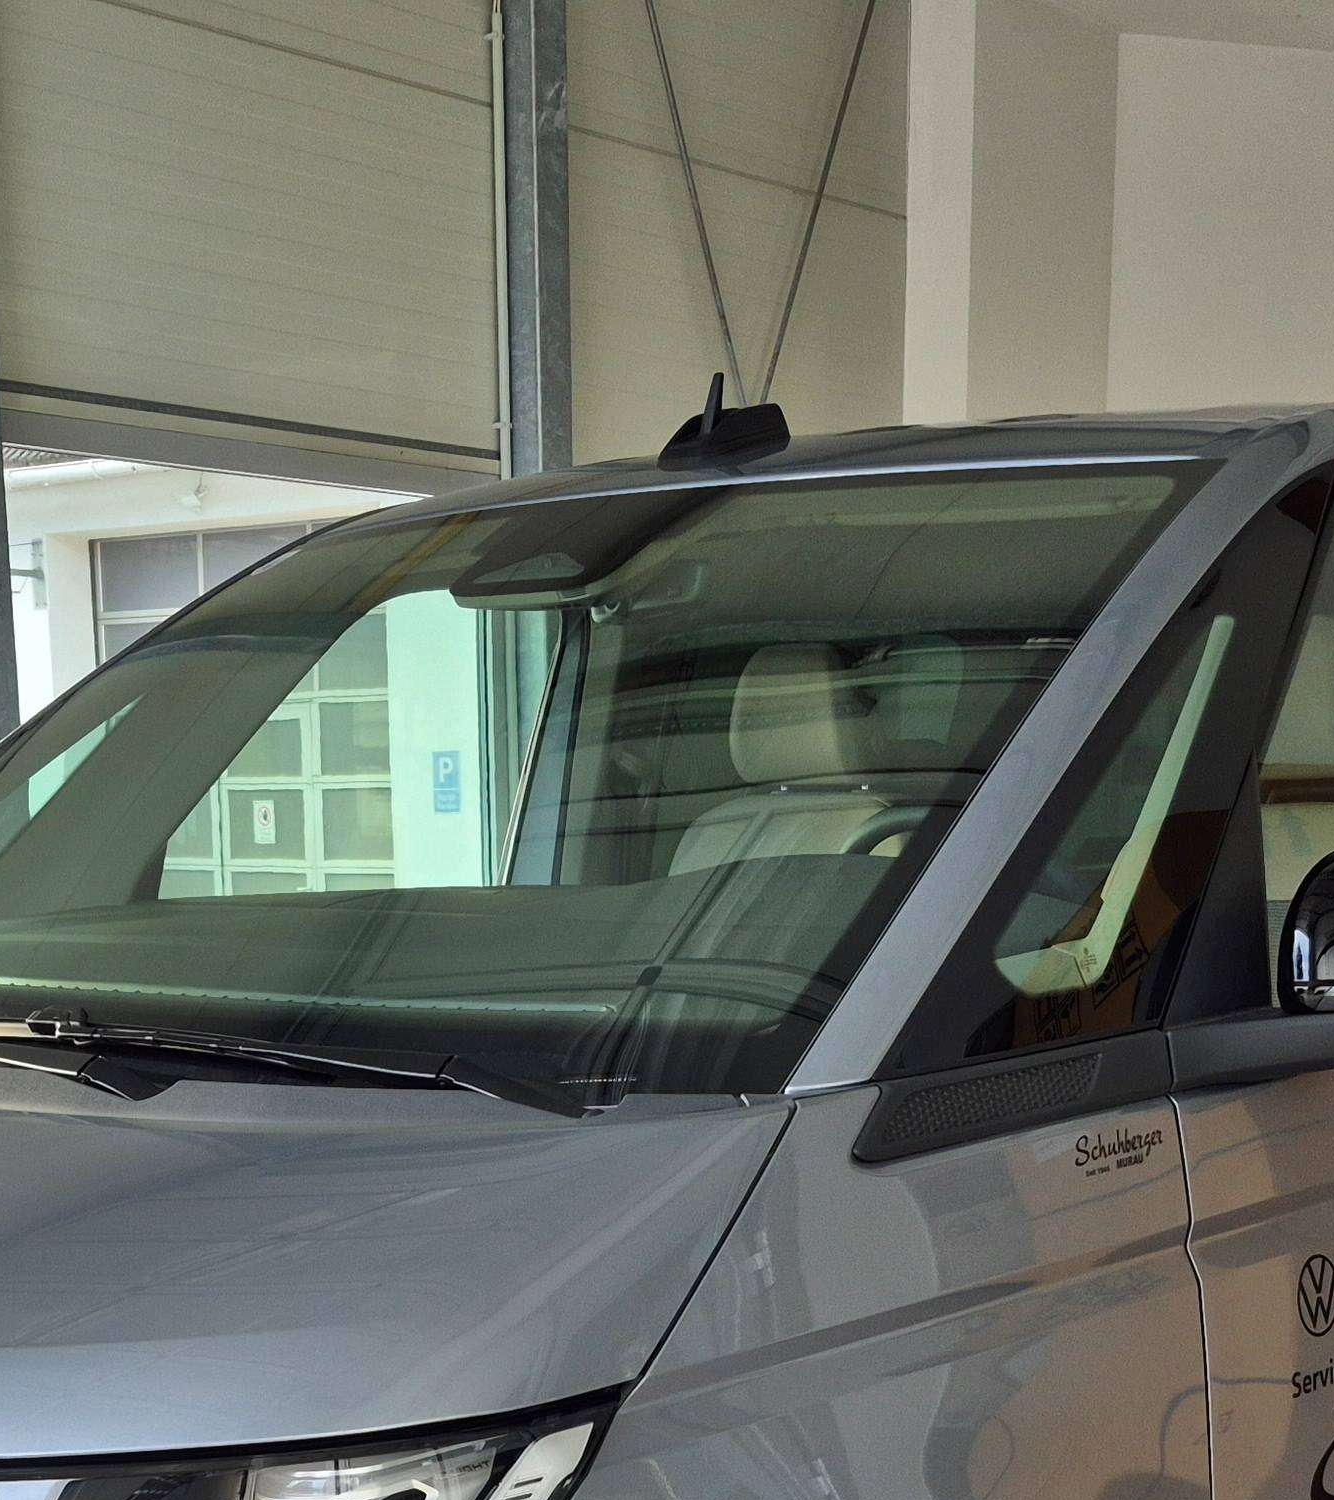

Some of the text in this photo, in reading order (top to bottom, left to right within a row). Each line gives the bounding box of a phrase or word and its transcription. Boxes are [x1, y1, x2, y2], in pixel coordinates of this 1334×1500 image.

[439, 757, 453, 783] P
[1074, 1127, 1164, 1167] Schuhberger
[1116, 1153, 1144, 1169] MURAU
